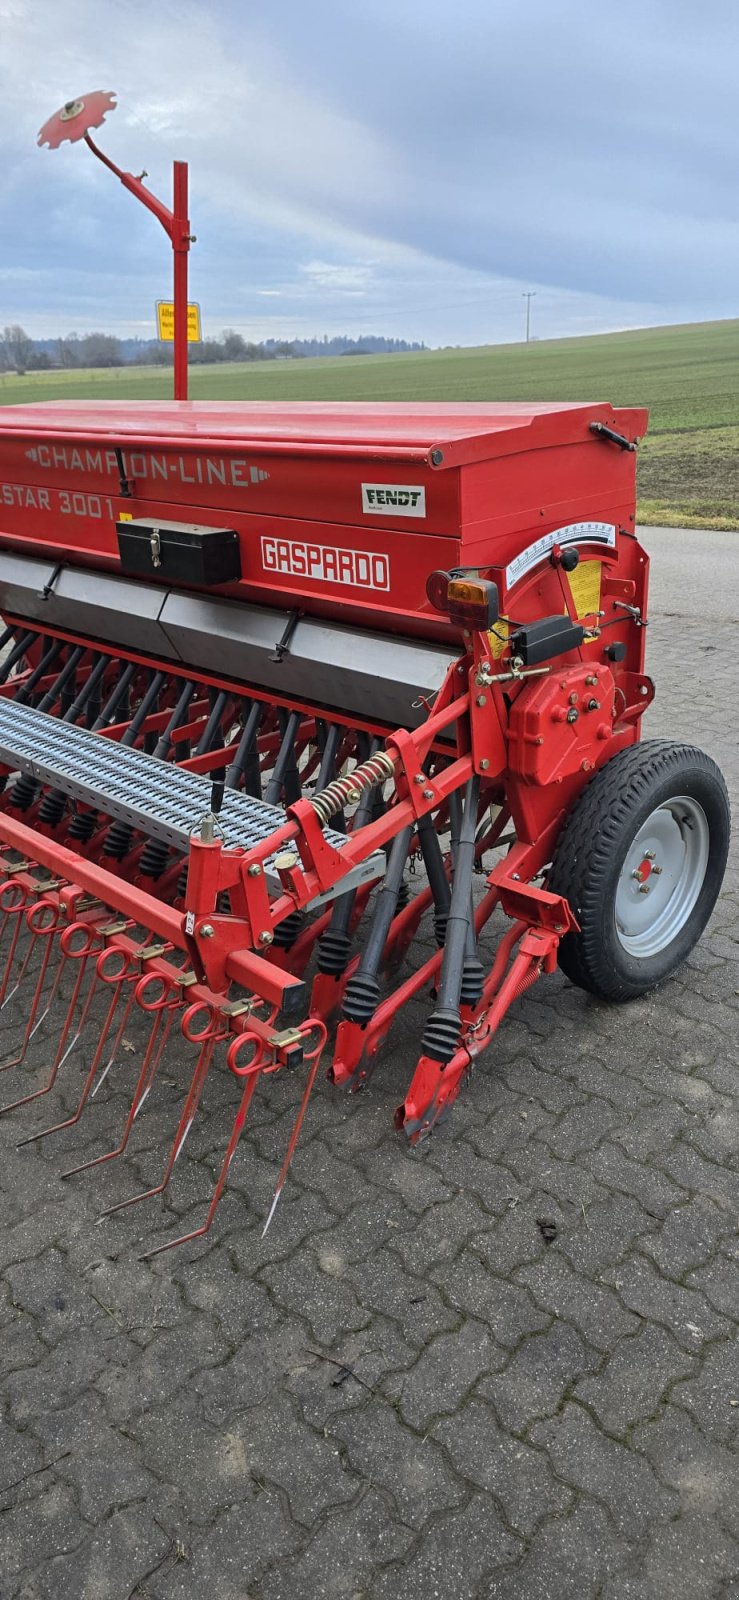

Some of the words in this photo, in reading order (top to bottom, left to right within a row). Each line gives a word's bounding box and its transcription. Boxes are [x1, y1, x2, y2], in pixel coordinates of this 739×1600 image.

[37, 445, 249, 487] CHAMPION-LINE
[0, 485, 52, 511] STAR
[59, 492, 114, 520] 3001
[366, 489, 421, 507] FENDT
[262, 538, 388, 589] GASPARDO
